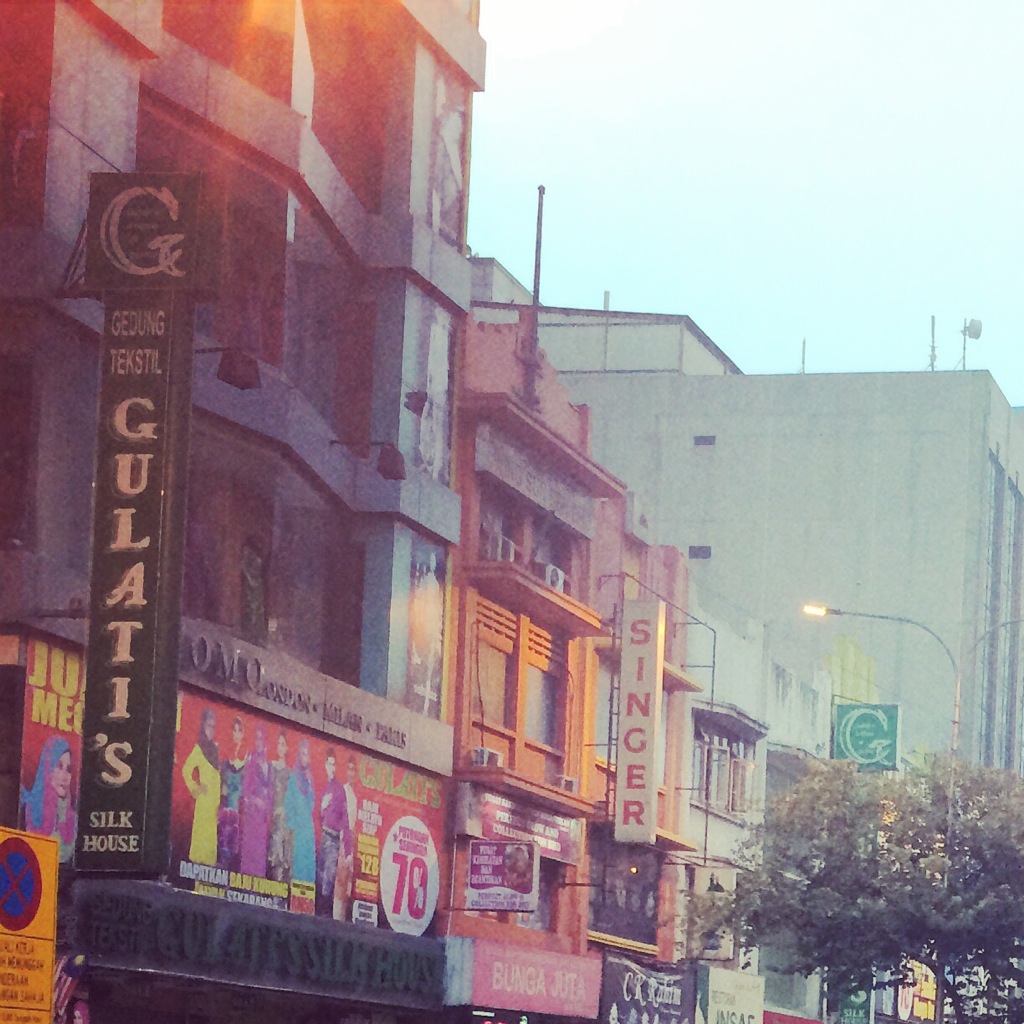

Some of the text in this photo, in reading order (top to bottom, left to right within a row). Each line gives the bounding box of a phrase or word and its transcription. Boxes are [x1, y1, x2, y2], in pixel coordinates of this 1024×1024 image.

[111, 310, 165, 336] GEDUNG
[110, 349, 162, 374] TEKSTIL
[94, 397, 158, 788] GULATI'S
[28, 640, 86, 698] JU
[622, 618, 652, 827] SINGER
[89, 810, 133, 829] SILK
[82, 834, 140, 853] HOUSE
[180, 860, 229, 886] DAPATKAN
[492, 960, 586, 1001] BUNGA JUTA
[844, 1008, 865, 1017] SILK
